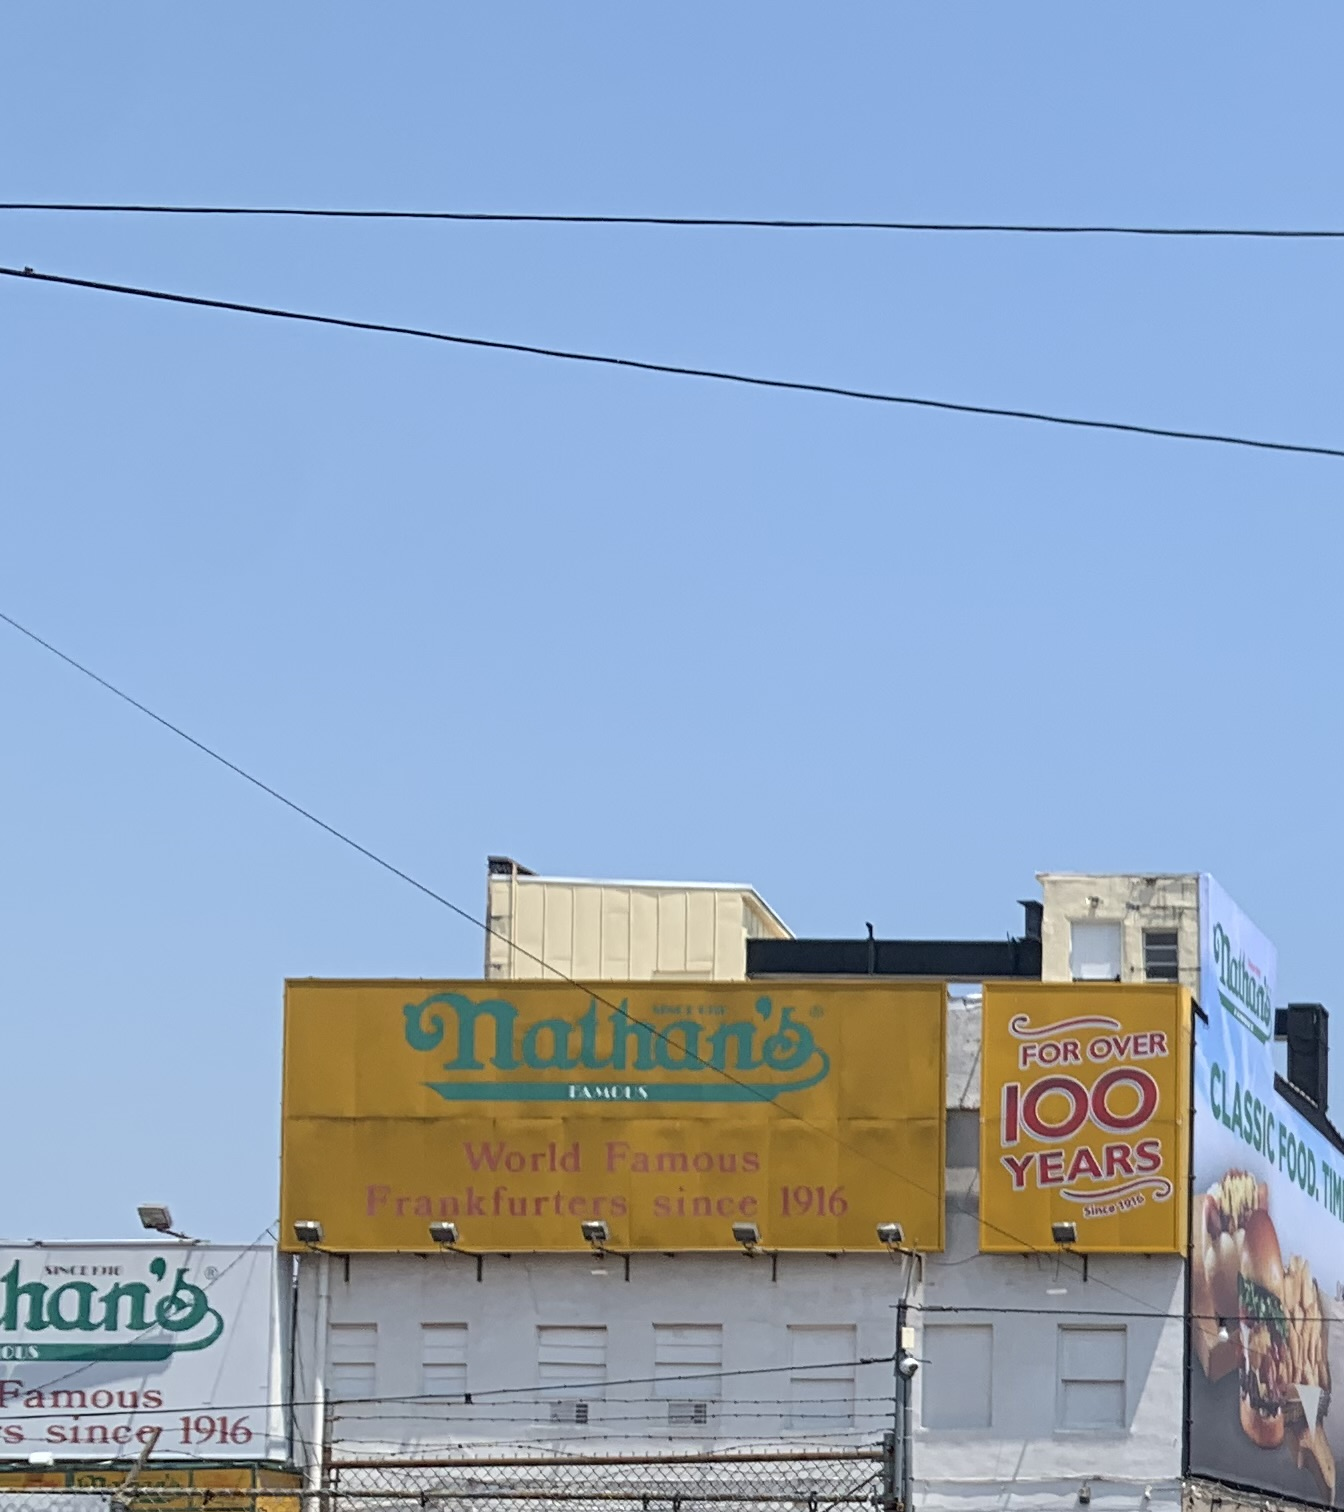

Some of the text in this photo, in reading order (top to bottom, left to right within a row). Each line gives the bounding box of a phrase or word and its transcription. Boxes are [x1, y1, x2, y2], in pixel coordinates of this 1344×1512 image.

[403, 992, 820, 1071] Nathan's
[1019, 1031, 1168, 1069] FOR OVER
[568, 1085, 648, 1099] FAMOUS
[1002, 1066, 1159, 1147] 100
[1210, 1062, 1275, 1165] CLASSIC
[1279, 1121, 1319, 1202] FOOD.
[463, 1141, 760, 1173] World Famous
[1001, 1138, 1163, 1191] YEARS
[366, 1184, 848, 1217] Frankfurters since 1916
[0, 1257, 212, 1331] han's
[0, 1345, 39, 1360] OUS
[0, 1380, 163, 1409] Famous
[47, 1415, 162, 1444] since
[179, 1415, 253, 1445] 1916
